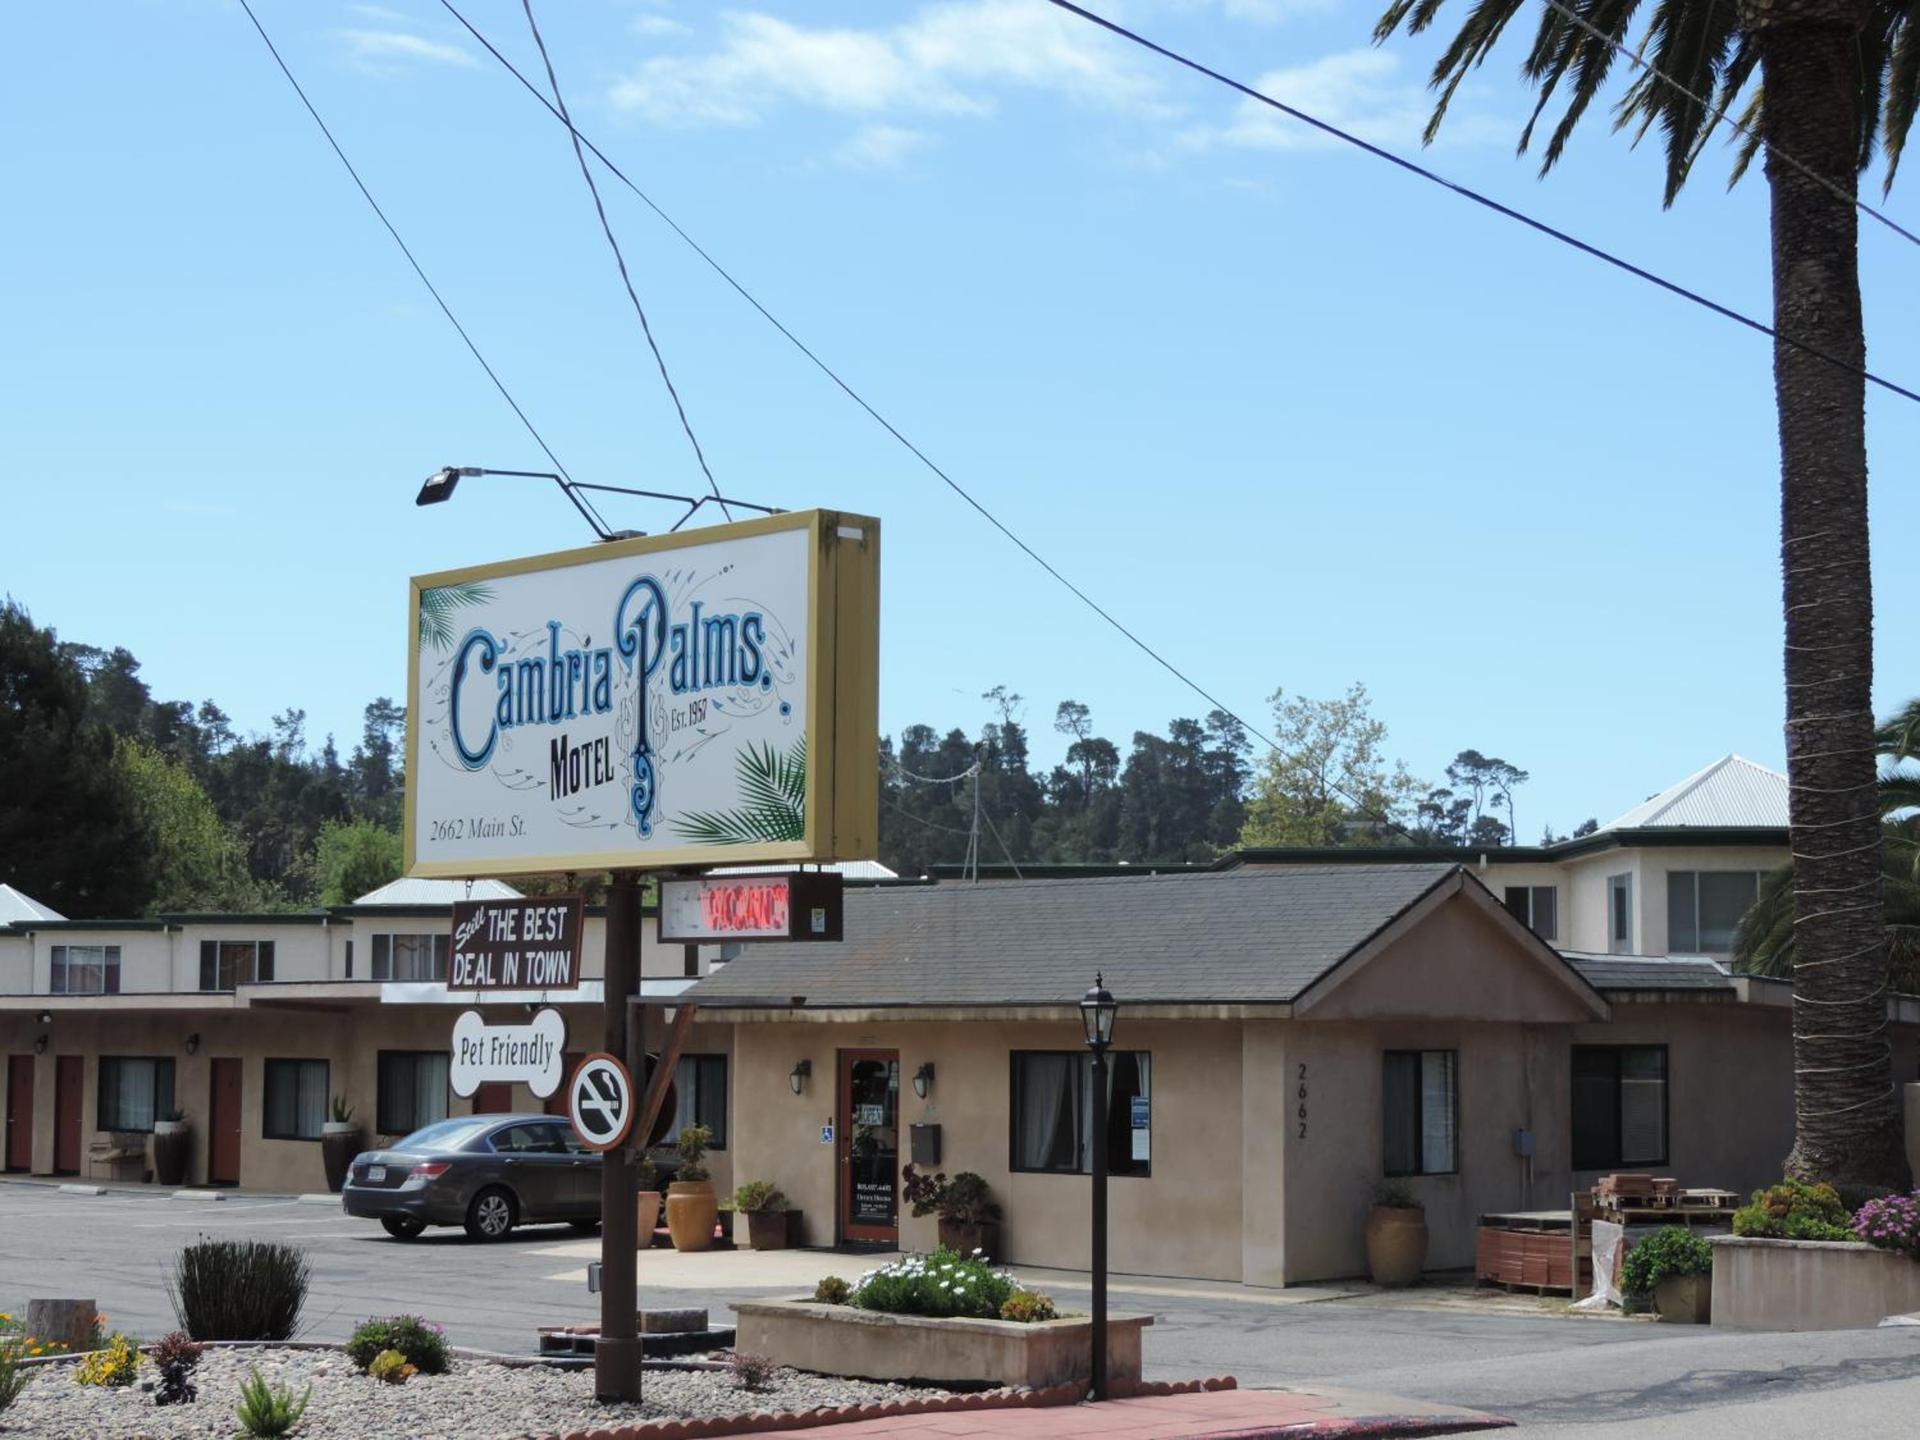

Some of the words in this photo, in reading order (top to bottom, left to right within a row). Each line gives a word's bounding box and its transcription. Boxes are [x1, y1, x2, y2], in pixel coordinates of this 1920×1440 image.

[450, 620, 614, 770] Cambria
[689, 698, 707, 726] 1957
[550, 734, 614, 801] MOTEL
[430, 818, 464, 841] 2662
[468, 816, 504, 839] Main
[508, 814, 527, 837] St.
[455, 905, 486, 950] Still
[488, 908, 518, 942] THE
[523, 906, 568, 941] BEST
[453, 952, 497, 986] DEAL
[502, 952, 519, 985] IN
[525, 950, 571, 985] TOWN
[460, 1036, 485, 1066] Pet
[490, 1033, 553, 1074] Friendly
[1297, 1063, 1307, 1139] 2662
